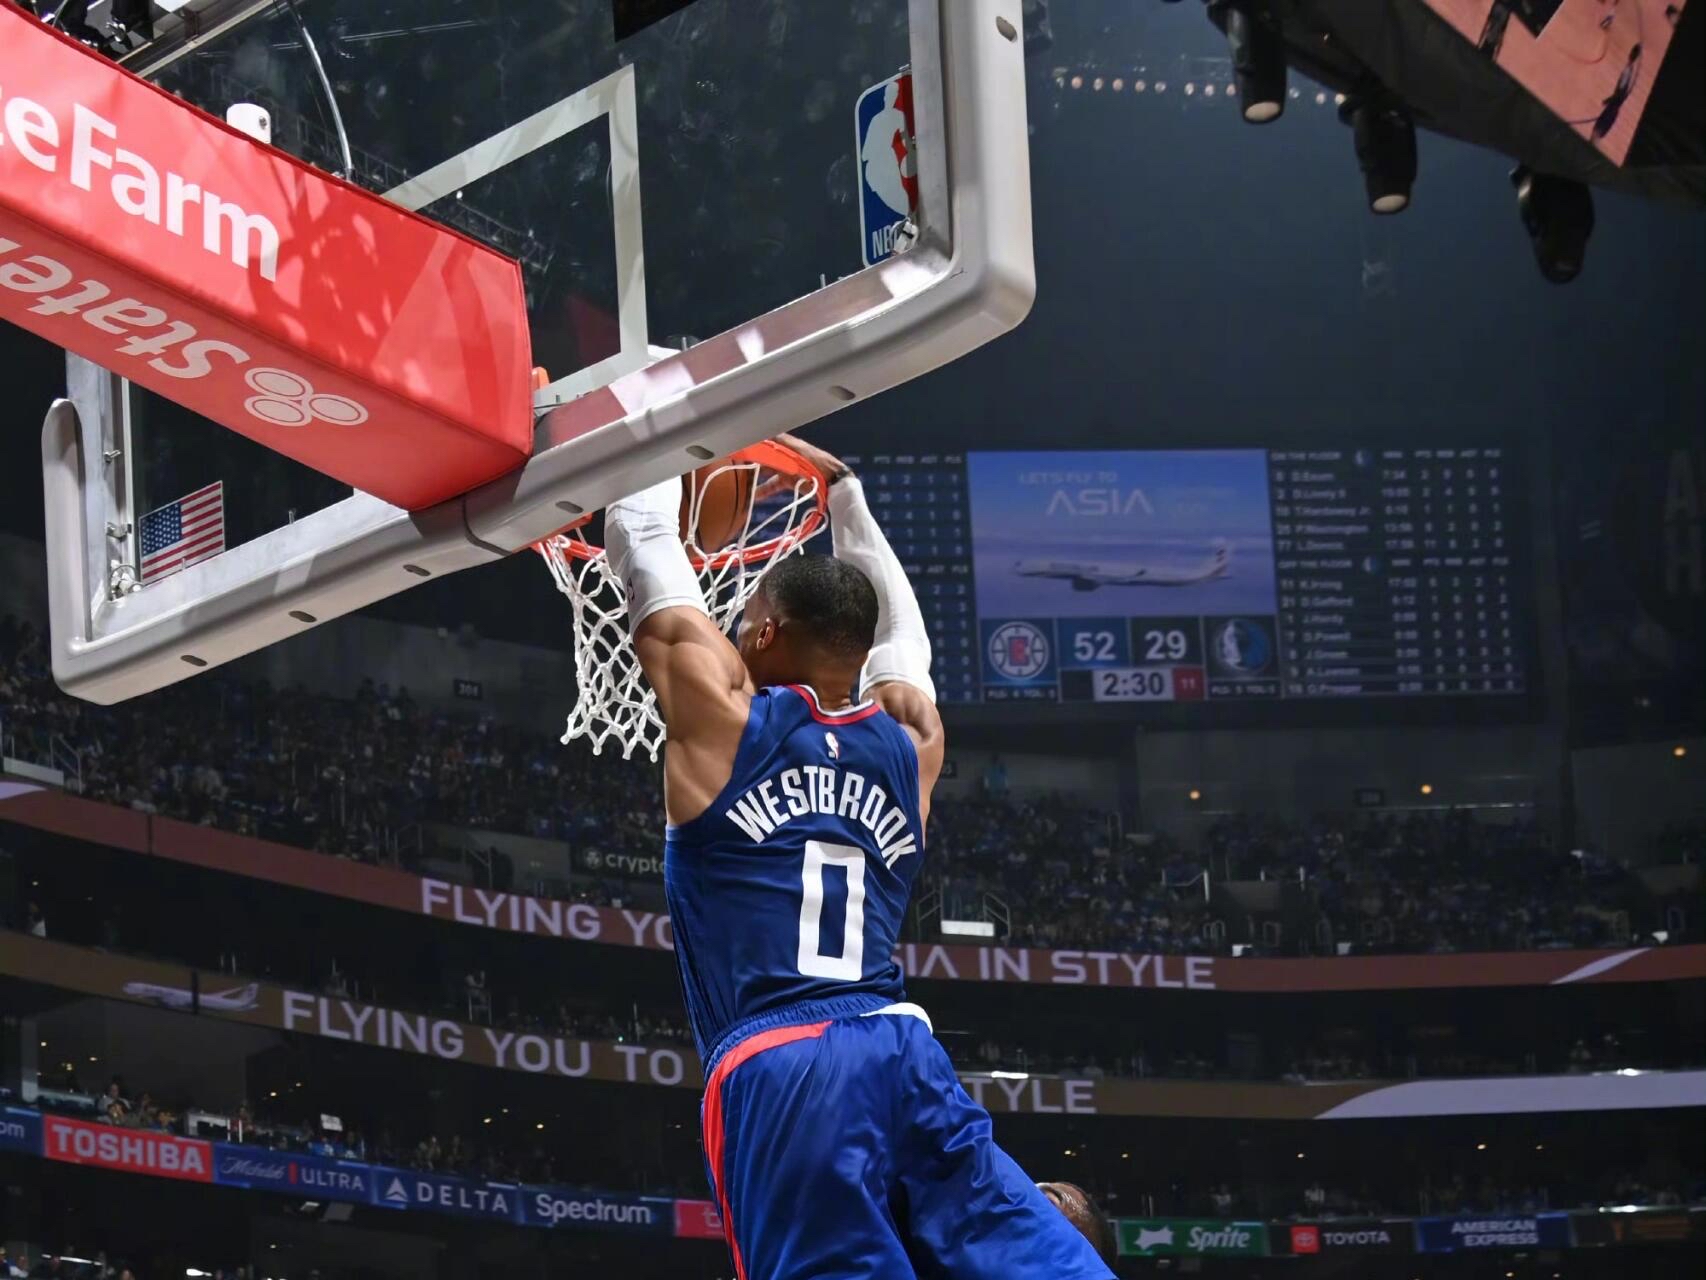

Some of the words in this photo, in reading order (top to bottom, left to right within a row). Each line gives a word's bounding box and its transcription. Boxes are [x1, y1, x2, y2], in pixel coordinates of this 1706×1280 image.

[0, 87, 279, 282] eFarm
[0, 238, 250, 380] State
[1046, 488, 1155, 517] ASIA
[1074, 632, 1116, 661] 52
[1144, 630, 1187, 660] 29
[1102, 672, 1165, 697] 2:30
[725, 765, 917, 870] WESTBROOK
[797, 839, 866, 982] 0
[421, 877, 601, 941] FLYING
[979, 947, 1031, 982] IN
[1051, 951, 1217, 990] STYLE
[282, 990, 464, 1060] FLYING
[483, 1028, 591, 1078] YOU
[613, 1045, 684, 1086] TO
[962, 1077, 1098, 1114] TYLE
[52, 1124, 205, 1175] TOSHIBA
[301, 1167, 365, 1192] ULTRA
[416, 1182, 509, 1214] DELTA
[536, 1194, 652, 1224] Spectrum
[1187, 1226, 1251, 1251] Sprite
[1322, 1231, 1391, 1245] TOYOTA
[1451, 1220, 1537, 1235] AMERICAN
[1463, 1233, 1539, 1247] EXPRESS
